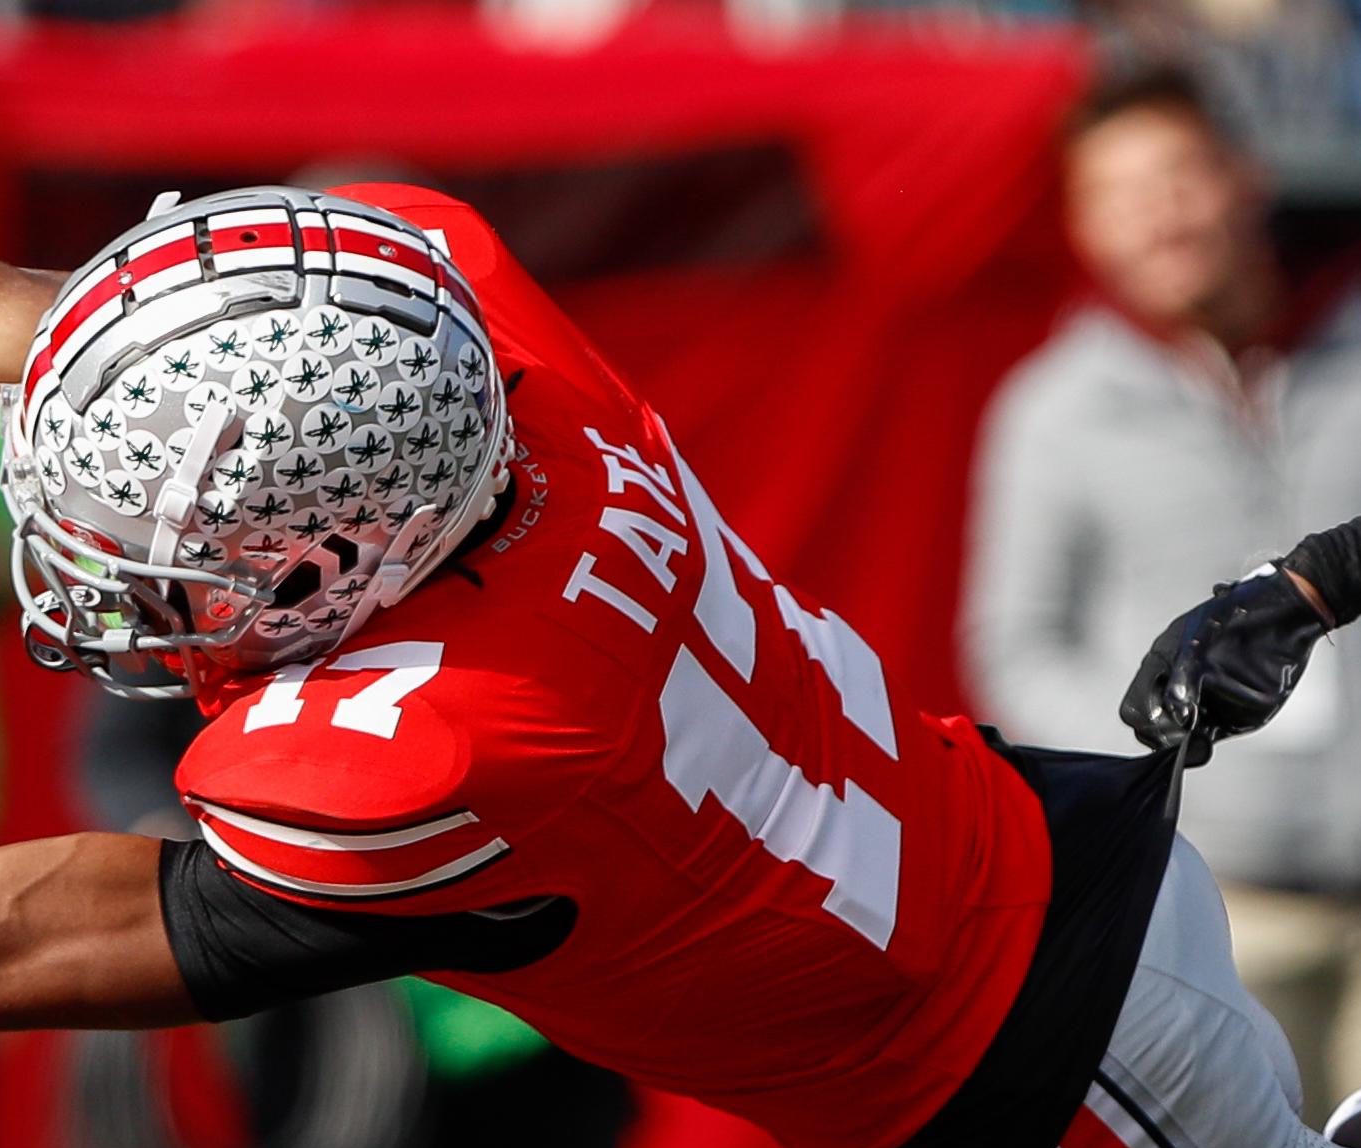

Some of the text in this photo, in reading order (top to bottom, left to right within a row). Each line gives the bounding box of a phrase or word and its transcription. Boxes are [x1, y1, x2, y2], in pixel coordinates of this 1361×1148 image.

[562, 426, 688, 634] TATE
[243, 640, 445, 739] 17
[659, 413, 901, 950] 17
